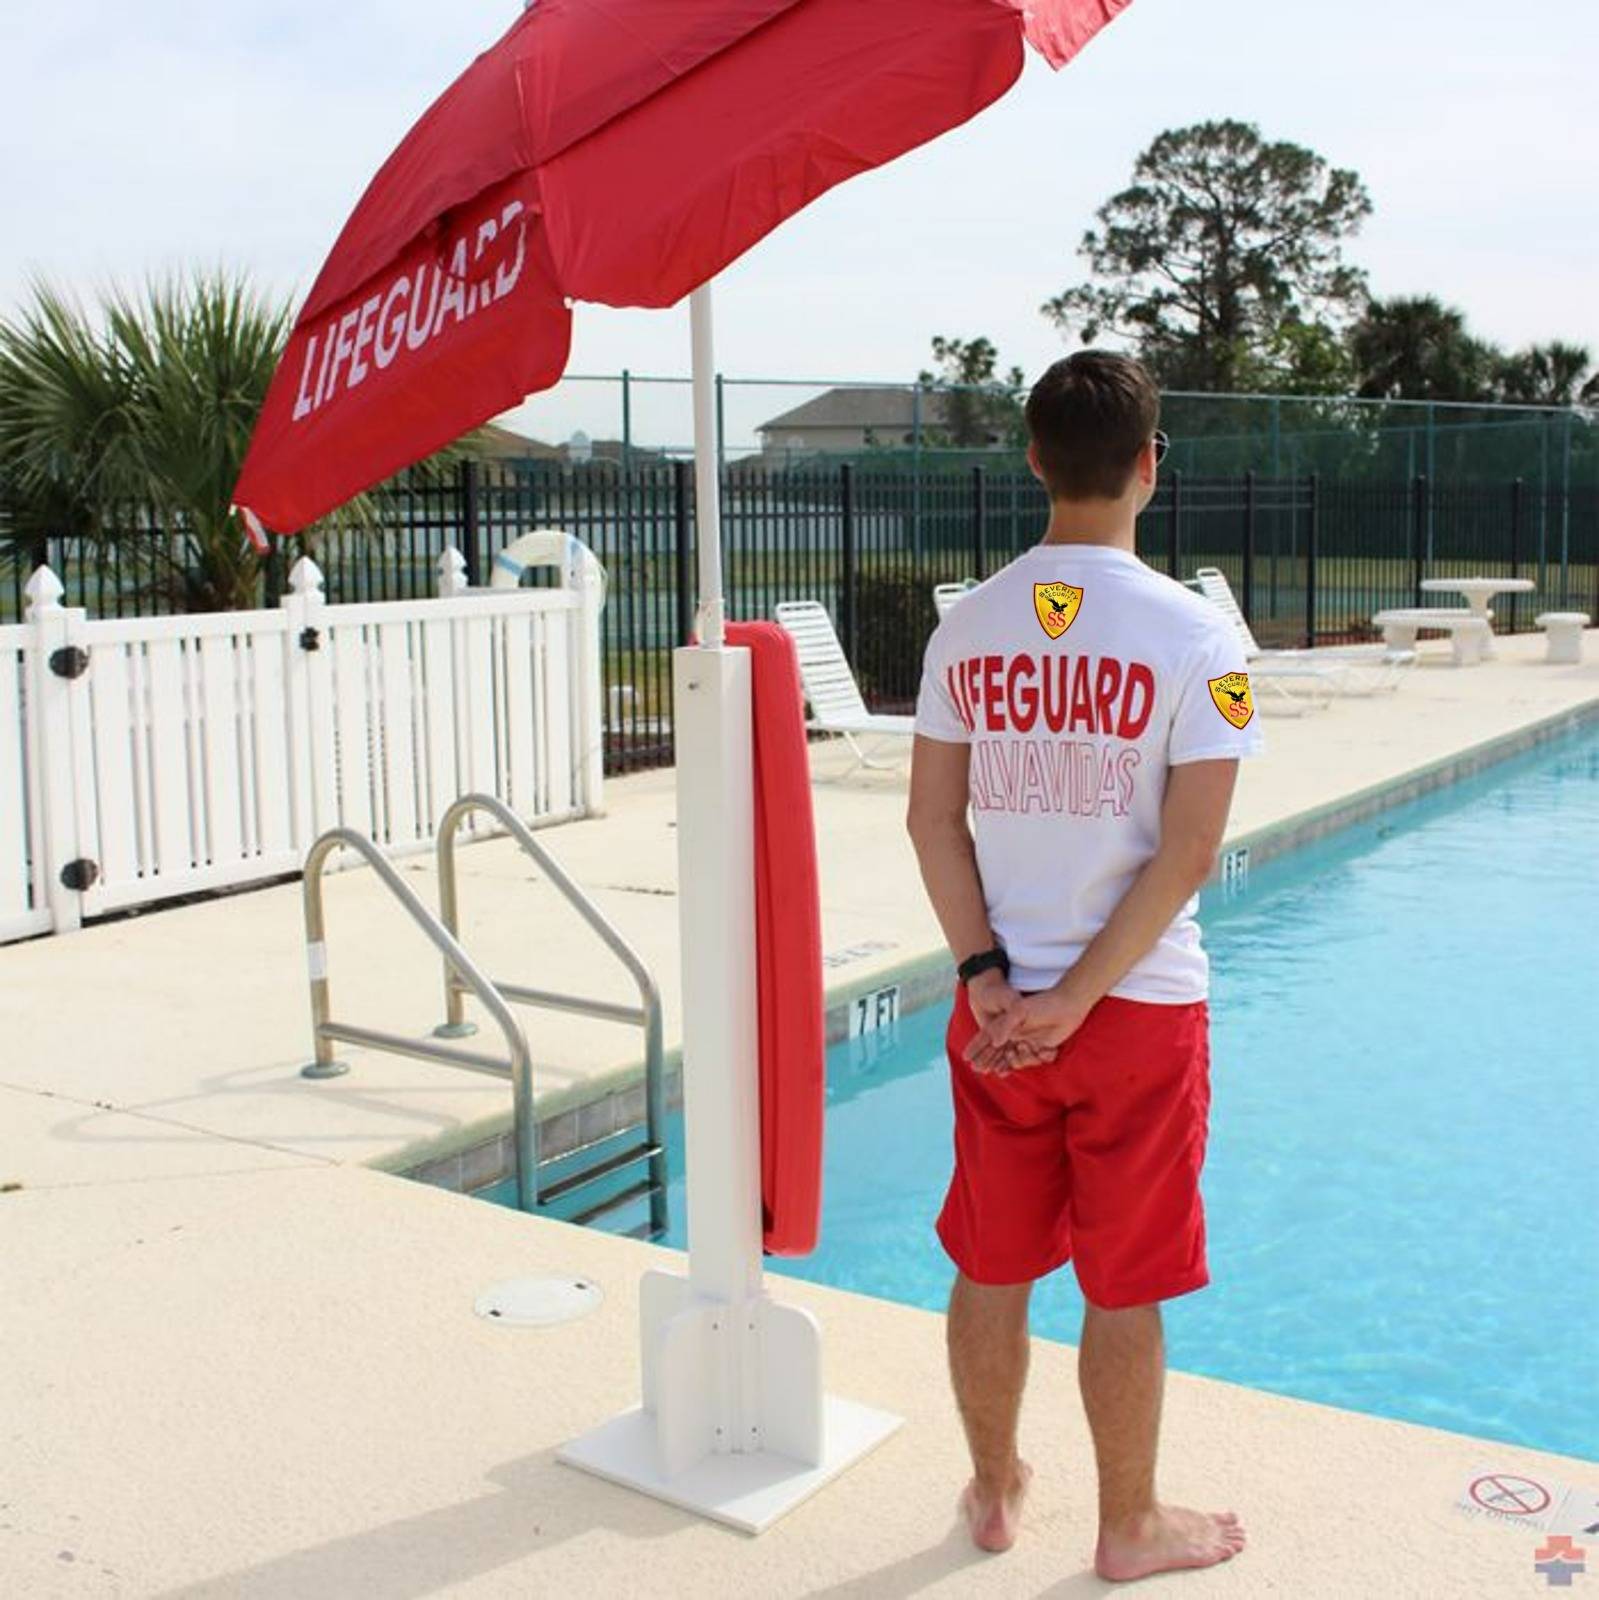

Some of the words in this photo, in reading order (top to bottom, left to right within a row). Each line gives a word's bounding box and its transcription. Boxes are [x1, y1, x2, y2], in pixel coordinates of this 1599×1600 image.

[292, 200, 525, 421] LIFEGUARD
[1039, 585, 1079, 601] SEVERITY
[1044, 591, 1072, 602] SECURITY
[1047, 612, 1066, 628] SS
[1215, 675, 1249, 692] SEVERIT
[1229, 701, 1249, 718] SS
[876, 986, 897, 1028] FT
